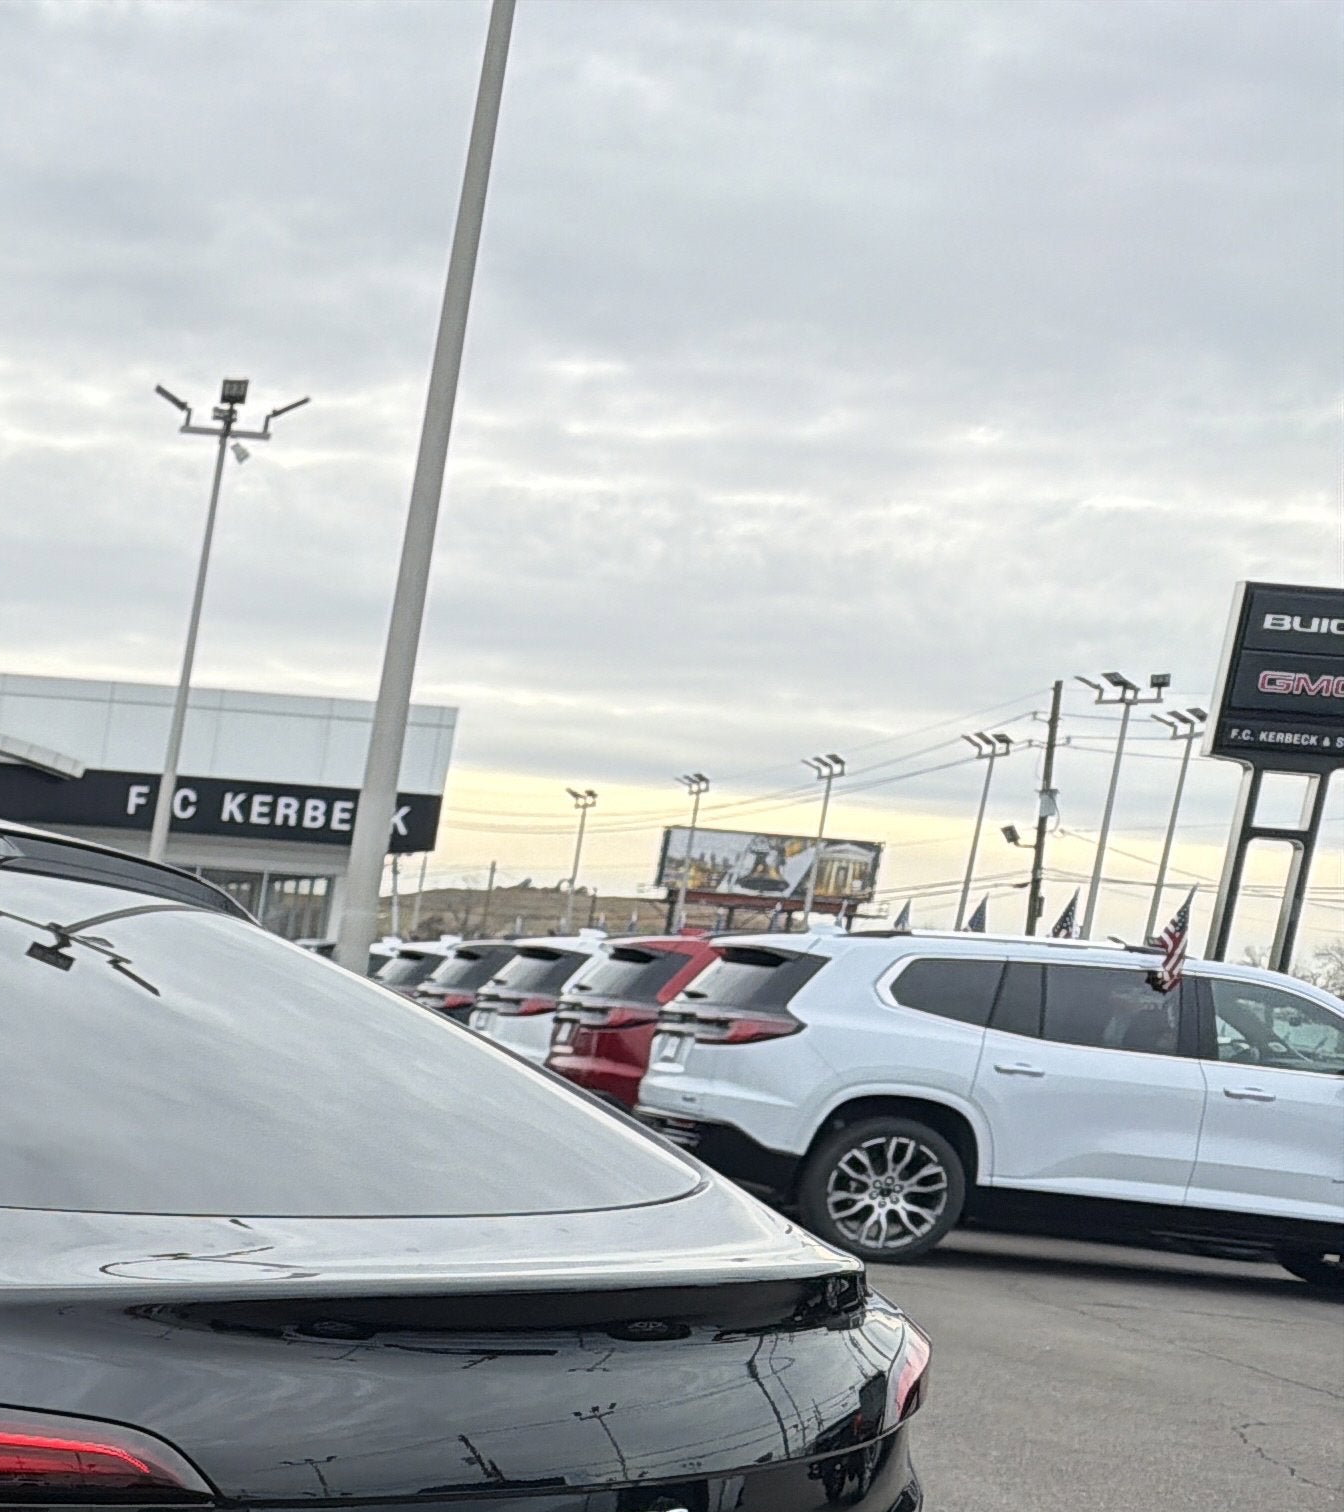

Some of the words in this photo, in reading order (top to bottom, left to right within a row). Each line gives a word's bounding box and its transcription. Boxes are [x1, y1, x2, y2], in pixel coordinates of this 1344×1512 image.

[1230, 728, 1255, 742] F.C.
[1259, 730, 1319, 747] KERBECK
[220, 791, 412, 837] KERBEK
